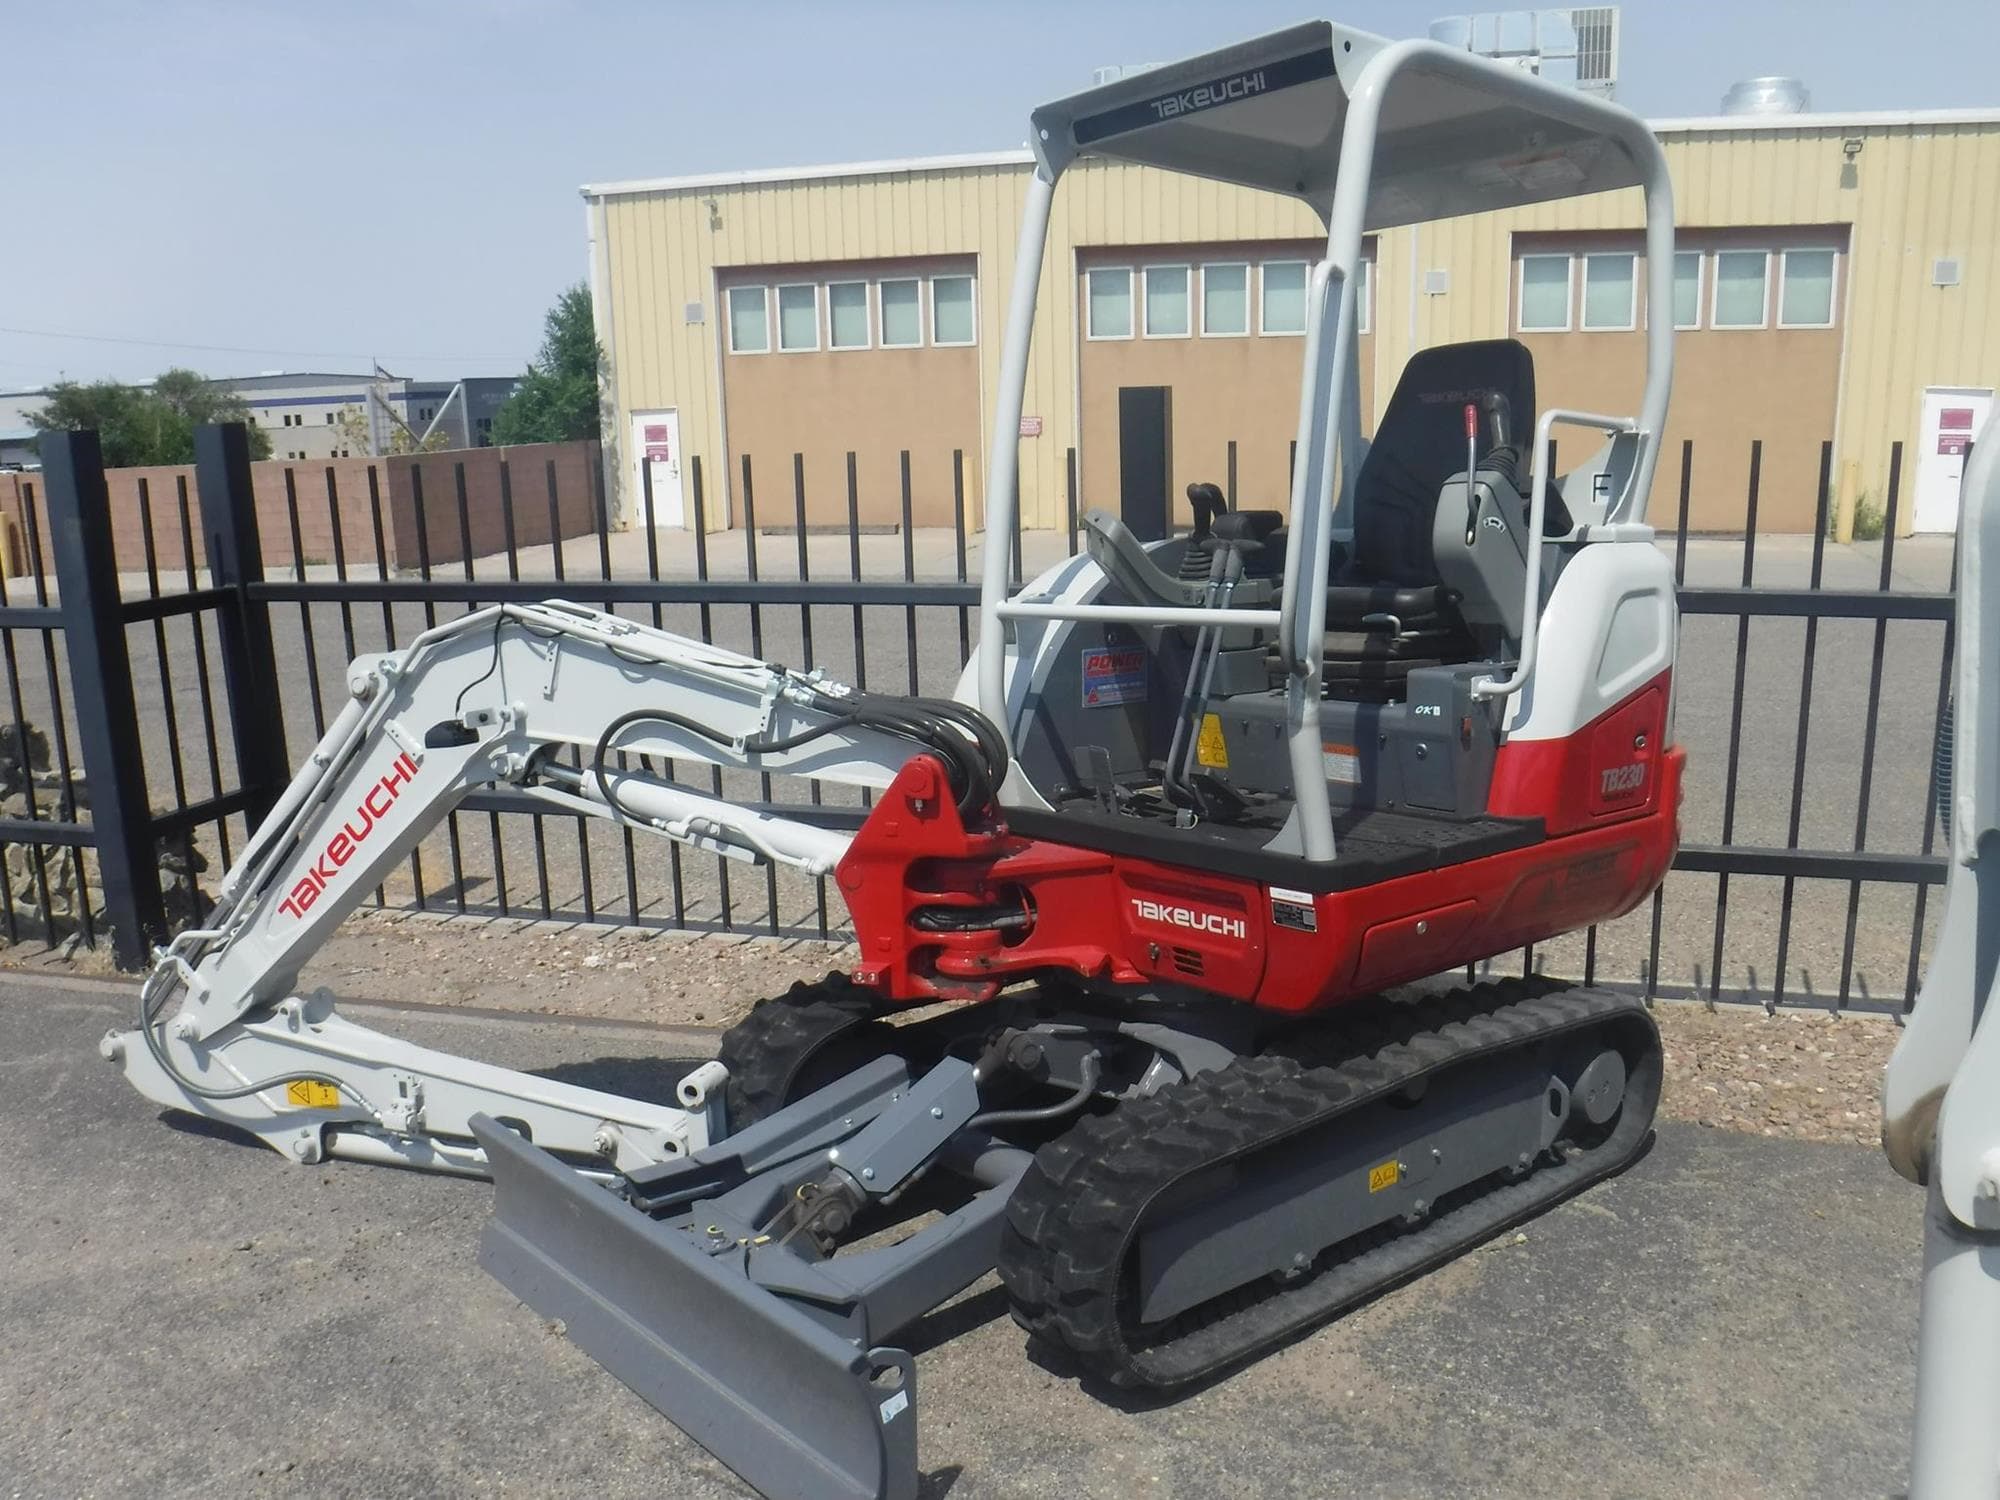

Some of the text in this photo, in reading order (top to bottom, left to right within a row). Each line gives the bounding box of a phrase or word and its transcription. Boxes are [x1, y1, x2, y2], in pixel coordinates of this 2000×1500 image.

[1151, 71, 1266, 118] TAKEUCHI
[1593, 473, 1612, 503] F
[1601, 762, 1646, 794] TB230
[278, 752, 419, 919] TAKEUCHI
[1131, 898, 1245, 939] TAKEUCHI
